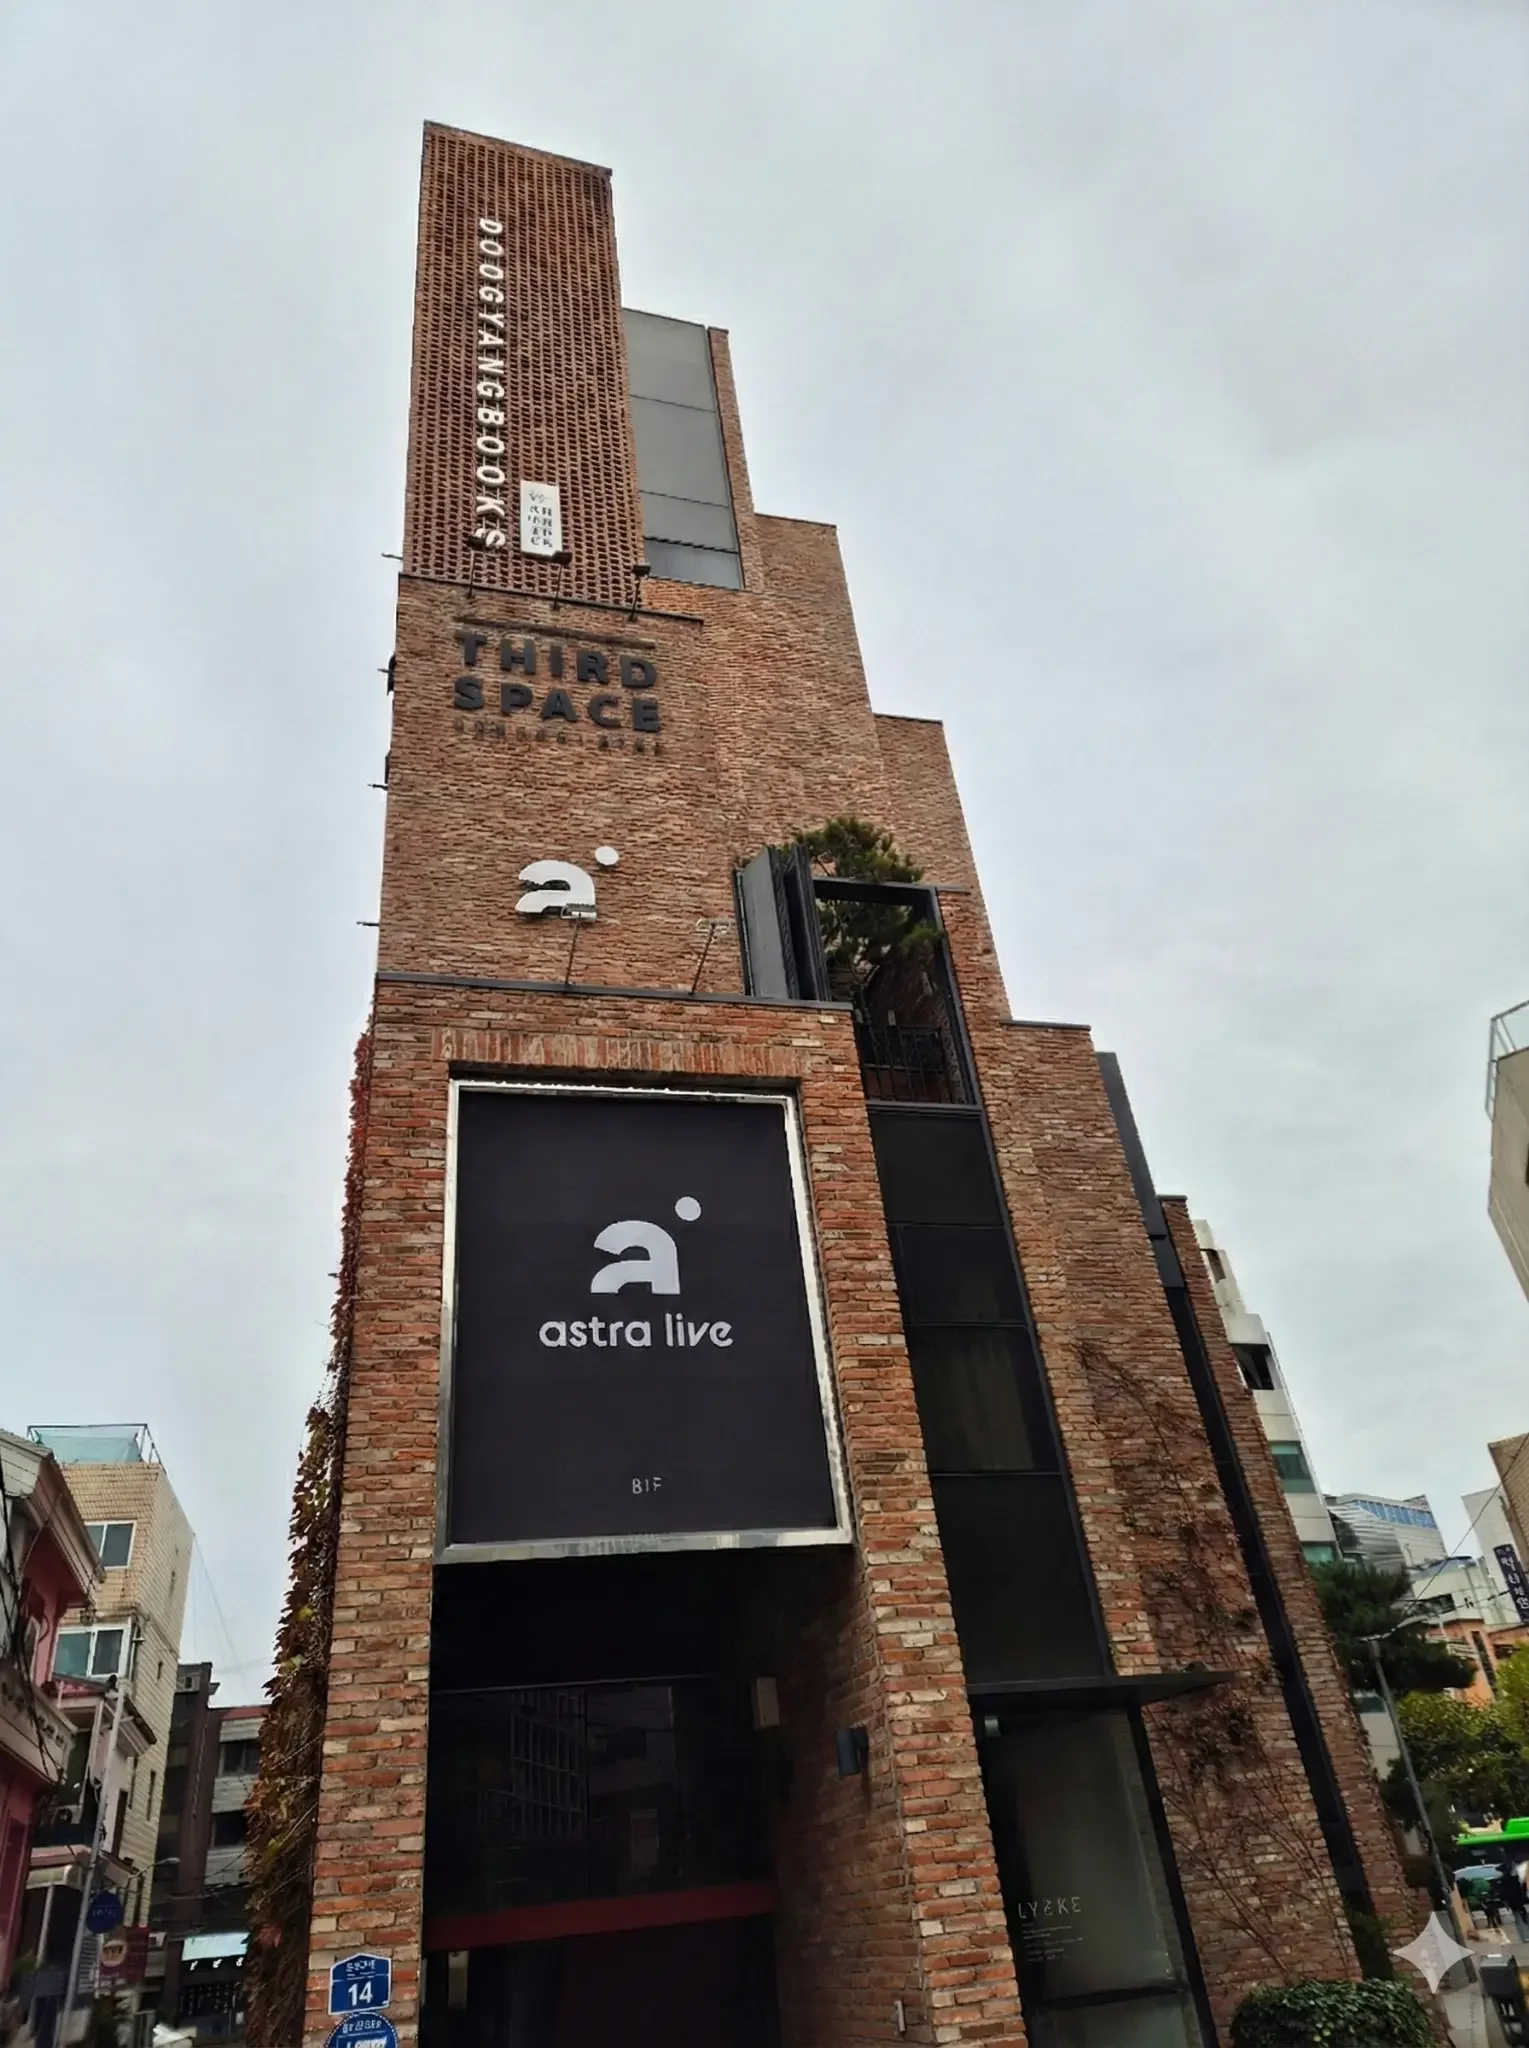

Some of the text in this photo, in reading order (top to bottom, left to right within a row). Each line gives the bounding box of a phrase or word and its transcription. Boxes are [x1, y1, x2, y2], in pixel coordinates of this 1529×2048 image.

[476, 218, 506, 549] DOOGYANGBOOKS
[456, 632, 658, 690] THIRD
[454, 674, 661, 733] SPACE
[538, 1313, 733, 1347] astra live
[348, 1981, 373, 2006] 14
